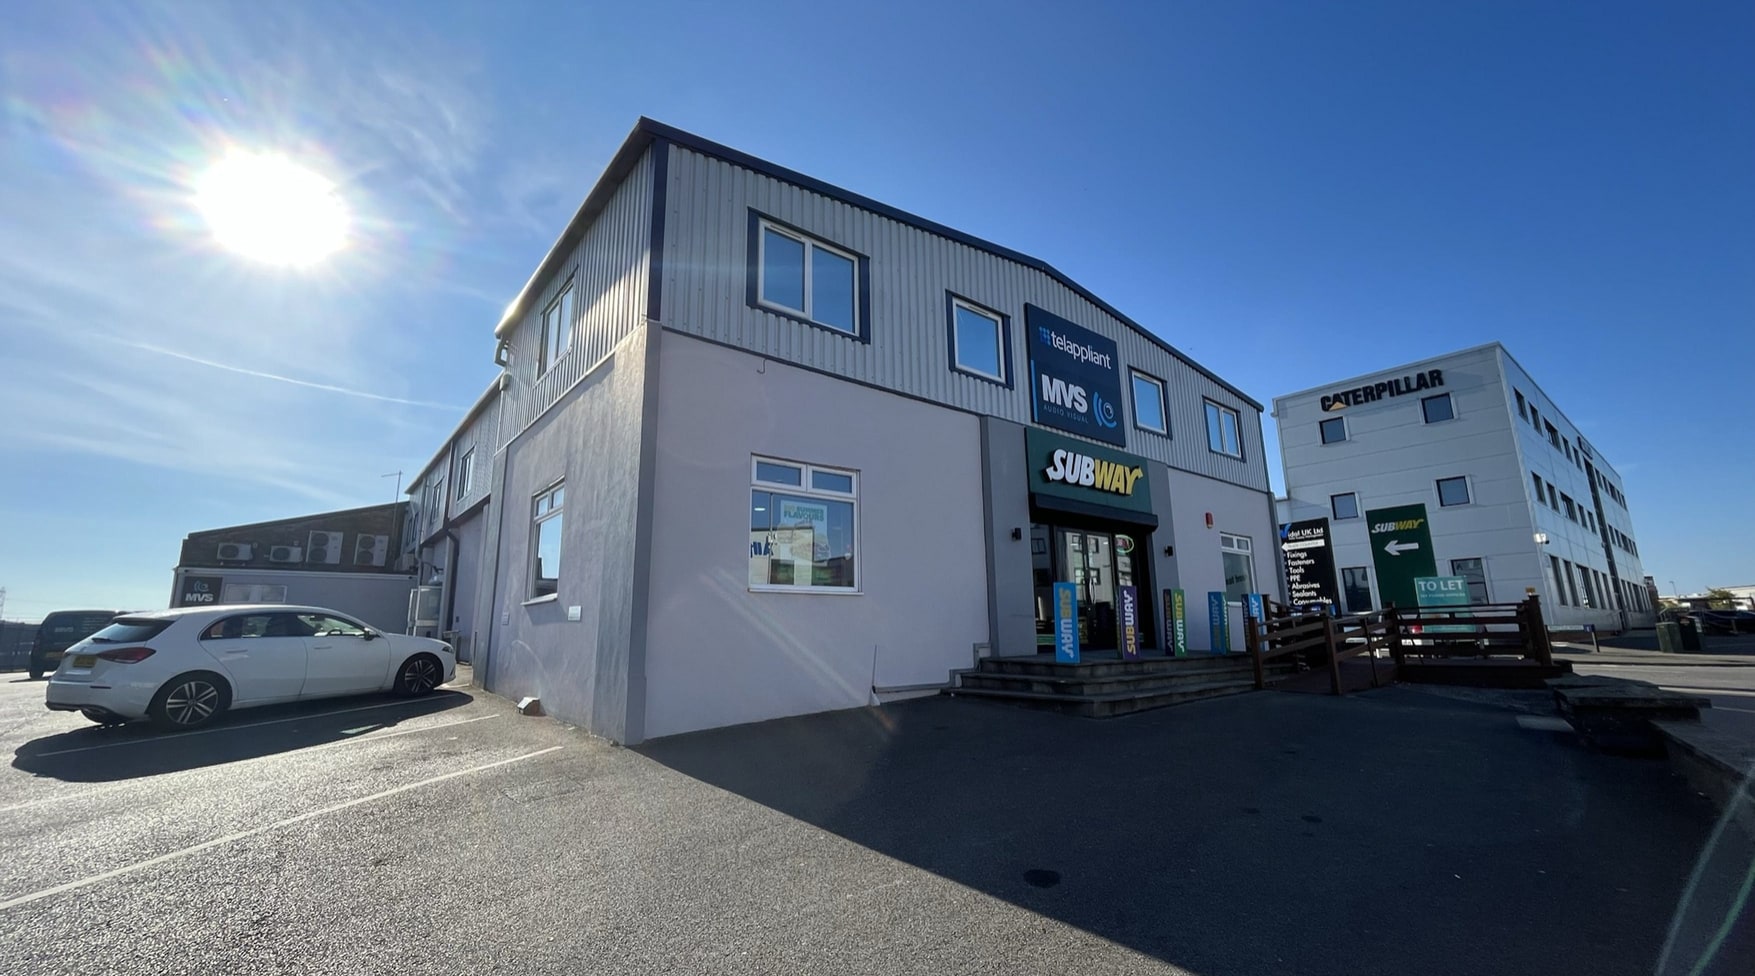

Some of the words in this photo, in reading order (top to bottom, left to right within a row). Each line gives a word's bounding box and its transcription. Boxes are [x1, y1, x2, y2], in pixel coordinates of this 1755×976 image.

[1050, 331, 1111, 370] telappliant
[1041, 374, 1088, 413] MVS
[1320, 369, 1444, 412] CATERPILLAR
[1043, 404, 1064, 416] AUDIO
[1066, 410, 1089, 424] VISUAL
[1046, 448, 1143, 496] SUBWAY
[1301, 528, 1312, 536] UK
[1313, 527, 1324, 535] Ltd
[1371, 518, 1424, 534] SUBWAY
[1287, 551, 1307, 559] Fixings
[1287, 559, 1315, 567] Fasteners
[1292, 582, 1321, 590] Abrasives
[1292, 590, 1317, 598] Sealants
[1418, 581, 1437, 592] TO
[1440, 579, 1464, 591] LET
[185, 593, 214, 602] MVS
[1059, 587, 1075, 659] SUBWAY
[1123, 589, 1137, 656] SUBWAY
[1175, 592, 1185, 653] SUBWAY
